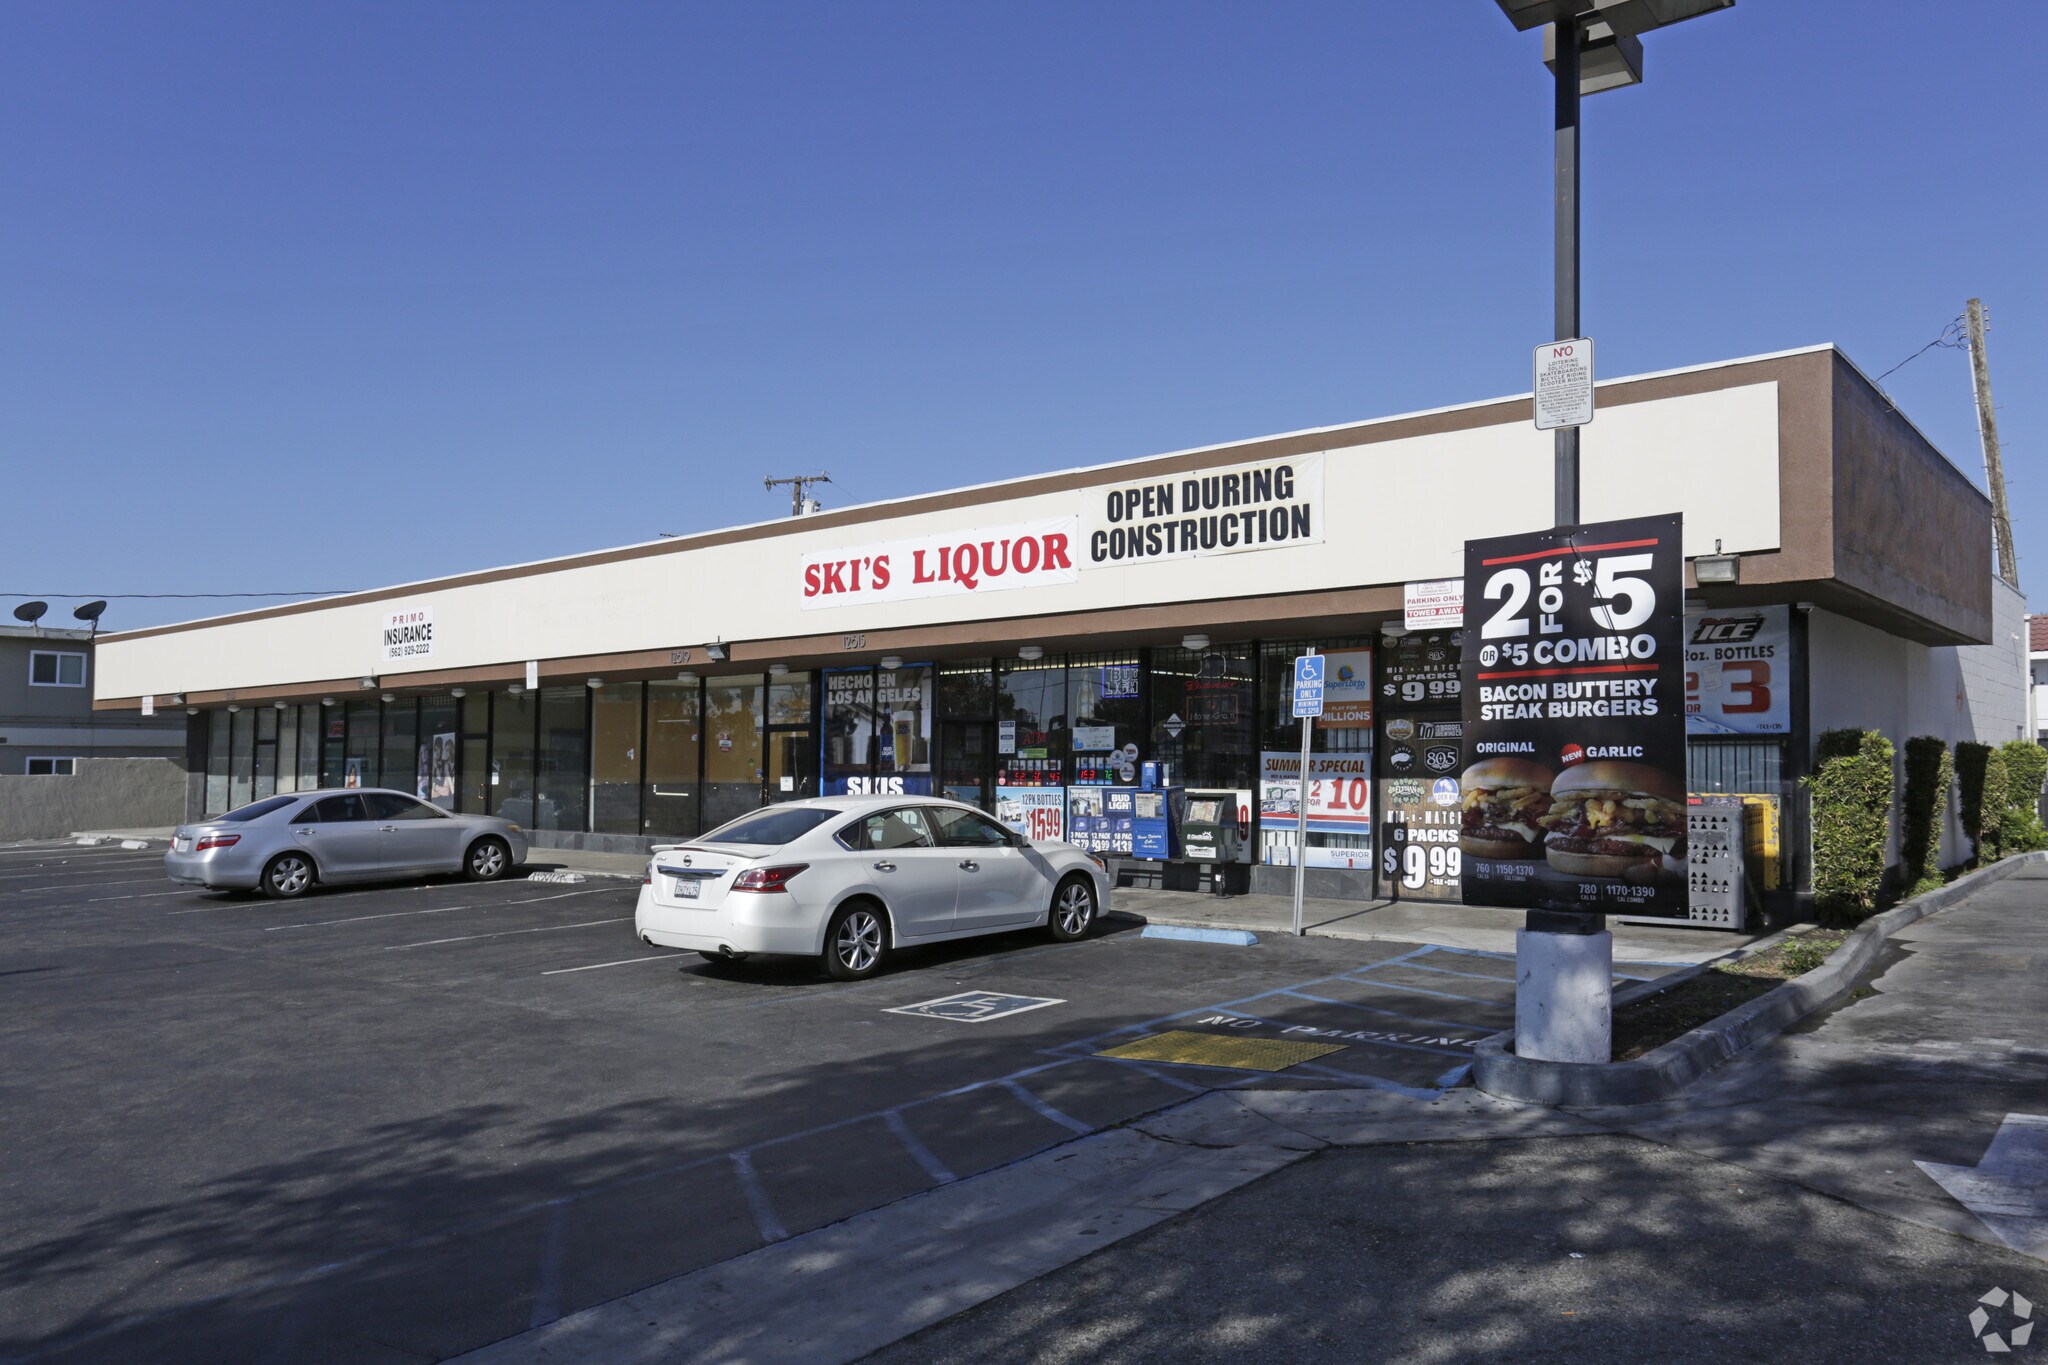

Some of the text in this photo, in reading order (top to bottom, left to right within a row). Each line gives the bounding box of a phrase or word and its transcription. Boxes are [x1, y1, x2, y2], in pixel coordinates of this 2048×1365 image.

[1553, 345, 1573, 359] NO
[1548, 357, 1578, 367] LOITERING
[1548, 362, 1579, 371] SOLICITING
[1540, 366, 1588, 378] SKATEBOARDING
[1541, 370, 1587, 383] BICYCLE RIDING
[1540, 379, 1566, 388] SCOOTER
[1106, 465, 1295, 523] OPEN DURING
[1089, 504, 1311, 563] CONSTRUCTION
[804, 533, 1073, 599] SKI'S LIQUOR
[1407, 596, 1441, 605] PARKING
[1442, 594, 1464, 603] ONLY
[1481, 553, 1657, 640] 2 FOR $5
[392, 612, 424, 625] PRIMO
[1408, 606, 1463, 617] TOWED AWAY
[384, 623, 432, 646] INSURANCE
[1697, 622, 1758, 642] ICE
[842, 633, 867, 650] 12615
[389, 647, 404, 659] (562)
[1482, 634, 1657, 666] OR $5 COMBO
[1715, 645, 1776, 660] BOTTLES
[671, 651, 691, 665] 12619
[828, 673, 896, 690] HECHO EN
[1407, 672, 1458, 681] PACKS
[1296, 679, 1323, 690] PARKING
[1480, 678, 1659, 703] BACON BUTTERY
[828, 687, 922, 705] LOS ANGELES
[1300, 689, 1317, 699] ONLY
[1296, 707, 1307, 715] FINE
[1297, 700, 1319, 708] MINIMUM
[1481, 698, 1659, 721] STEAK BURGERS
[1686, 703, 1701, 713] OR
[1319, 711, 1371, 722] MILLIONS
[1023, 731, 1048, 745] ATM
[1476, 741, 1535, 754] ORIGINAL
[1426, 752, 1457, 766] 805
[1561, 744, 1644, 766] NEW GARLIC
[1265, 758, 1366, 773] SUMMR SPECIAL
[1021, 794, 1036, 806] 12PK
[1037, 793, 1062, 806] BOTTLES
[1111, 793, 1130, 802] BUD
[1311, 776, 1368, 811] 2 10
[1307, 798, 1321, 807] FOR
[1235, 804, 1249, 842] 9
[1393, 828, 1459, 843] 6 PACKS
[1330, 850, 1370, 858] SUPERIOR
[1476, 863, 1534, 875] 760 1150-1370
[1578, 883, 1655, 898] 780 1170-1390
[1197, 1014, 1263, 1028] NO
